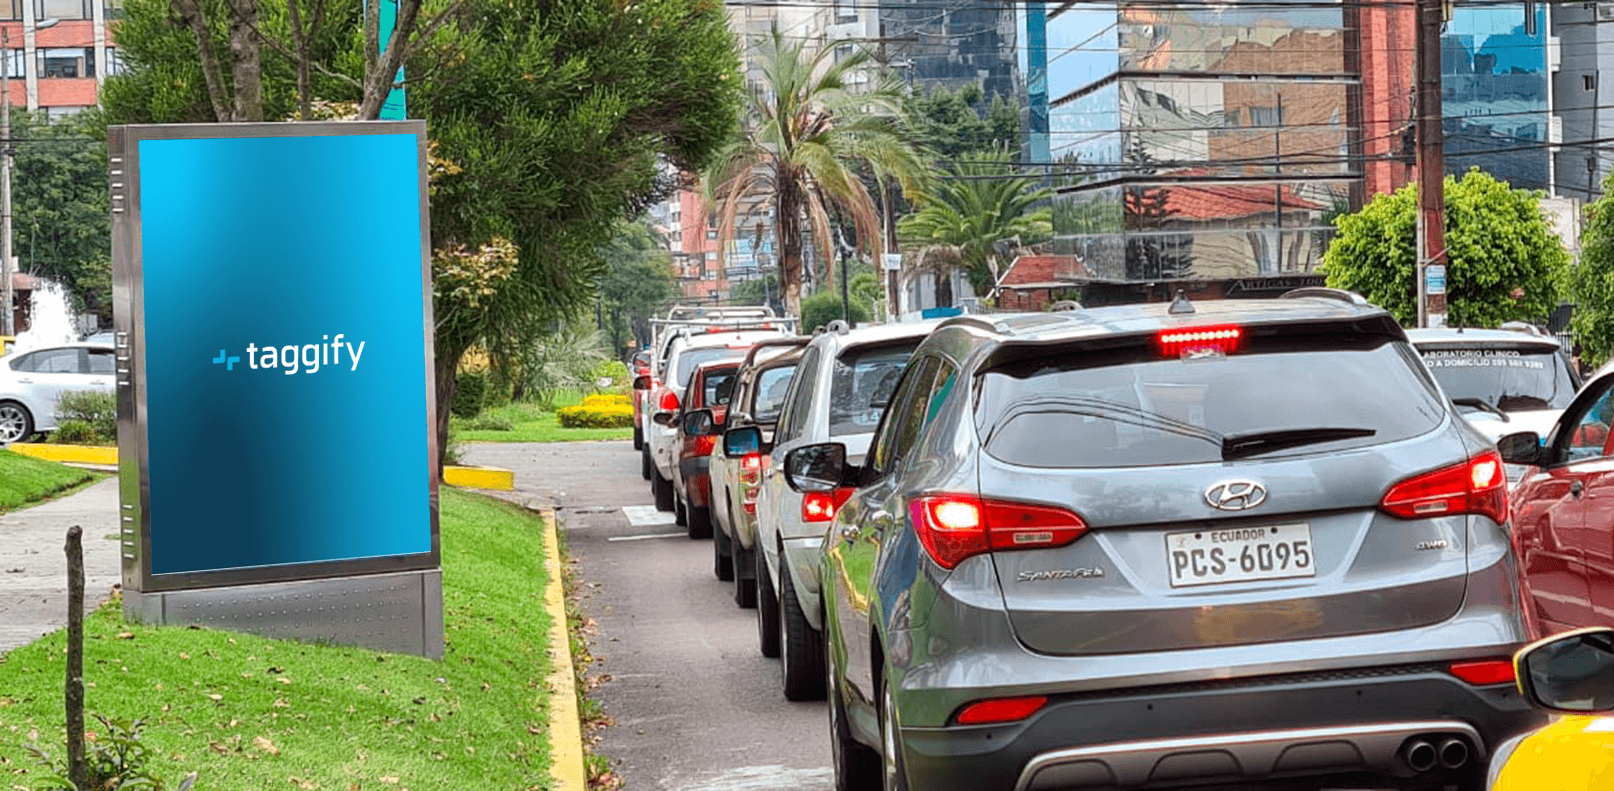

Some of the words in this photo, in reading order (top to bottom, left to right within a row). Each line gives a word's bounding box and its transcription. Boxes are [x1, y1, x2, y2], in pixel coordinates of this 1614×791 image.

[246, 334, 366, 375] taggify
[1444, 358, 1490, 367] DOMICILIO
[1211, 528, 1265, 543] ECUADOR
[1173, 541, 1310, 579] PCS-6095
